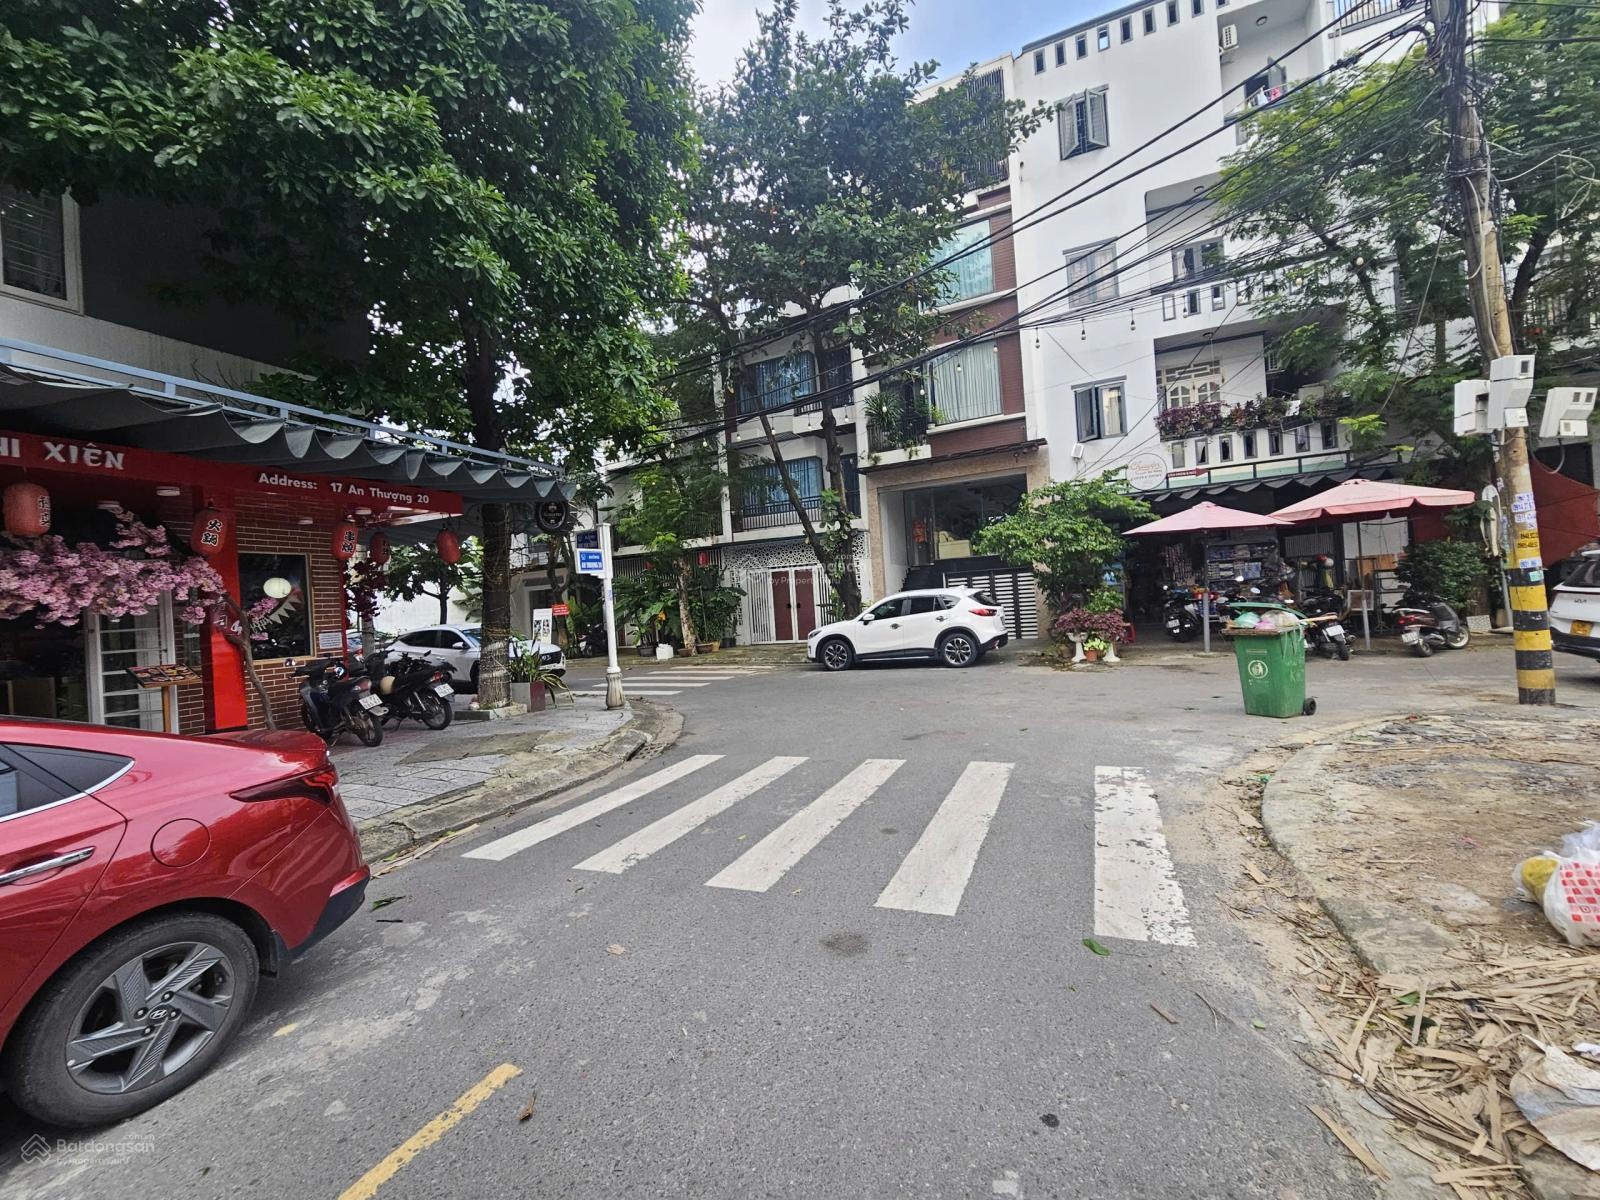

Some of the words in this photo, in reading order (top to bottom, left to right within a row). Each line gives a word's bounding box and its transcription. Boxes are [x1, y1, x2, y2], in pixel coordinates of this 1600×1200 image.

[43, 441, 125, 470] XIÊN
[258, 472, 318, 490] Address:
[330, 482, 343, 493] 17
[348, 484, 365, 496] An
[369, 487, 412, 504] Thượng
[417, 494, 430, 504] 20
